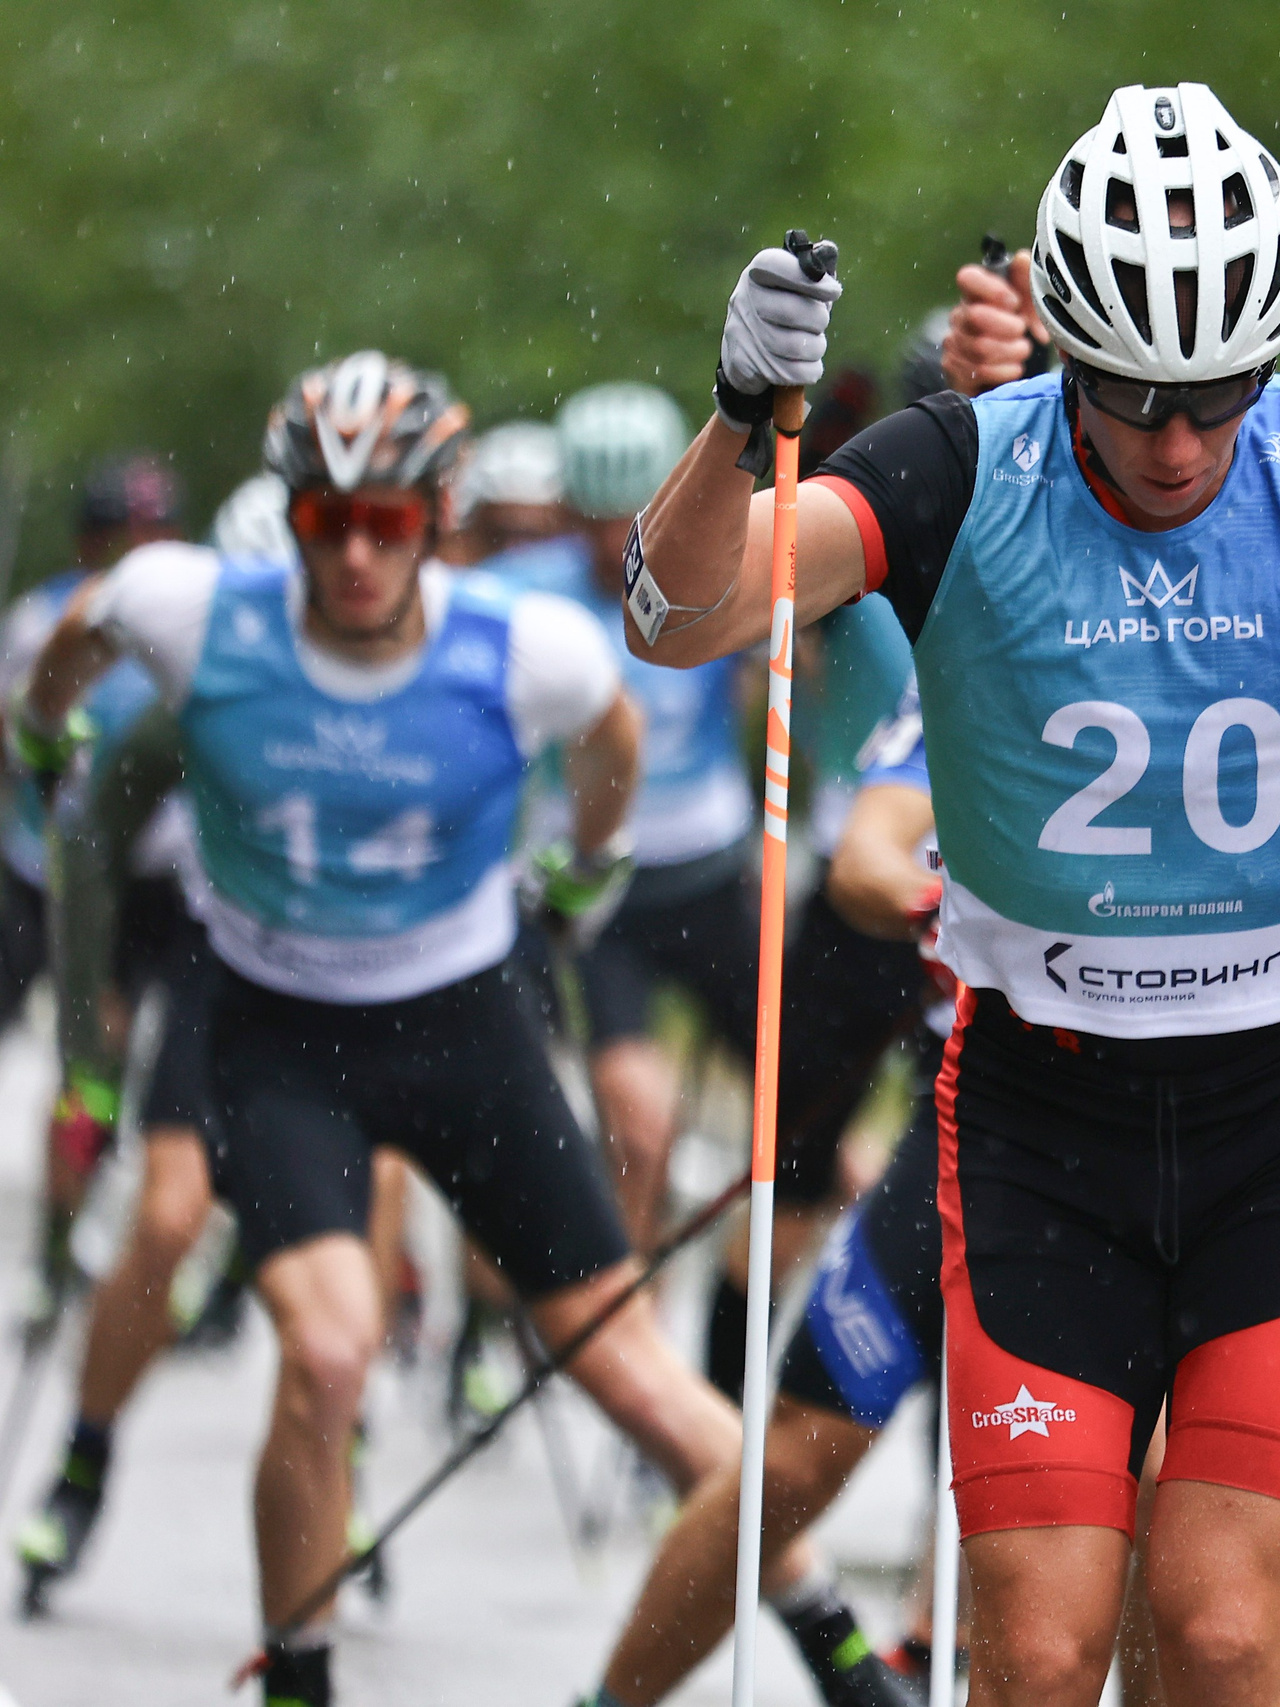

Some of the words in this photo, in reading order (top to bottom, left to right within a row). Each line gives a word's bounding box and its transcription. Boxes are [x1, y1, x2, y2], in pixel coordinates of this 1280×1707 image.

[1064, 617, 1161, 649] ЦАРЬ
[1167, 613, 1265, 643] ГОРЫ
[253, 792, 443, 885] 14
[1116, 903, 1184, 918] ГАЗПРОМ
[1188, 899, 1244, 916] ПОЛЯНА
[1081, 989, 1126, 1004] группа
[1129, 991, 1196, 1005] компаний
[971, 1406, 1077, 1429] CrosSRace
